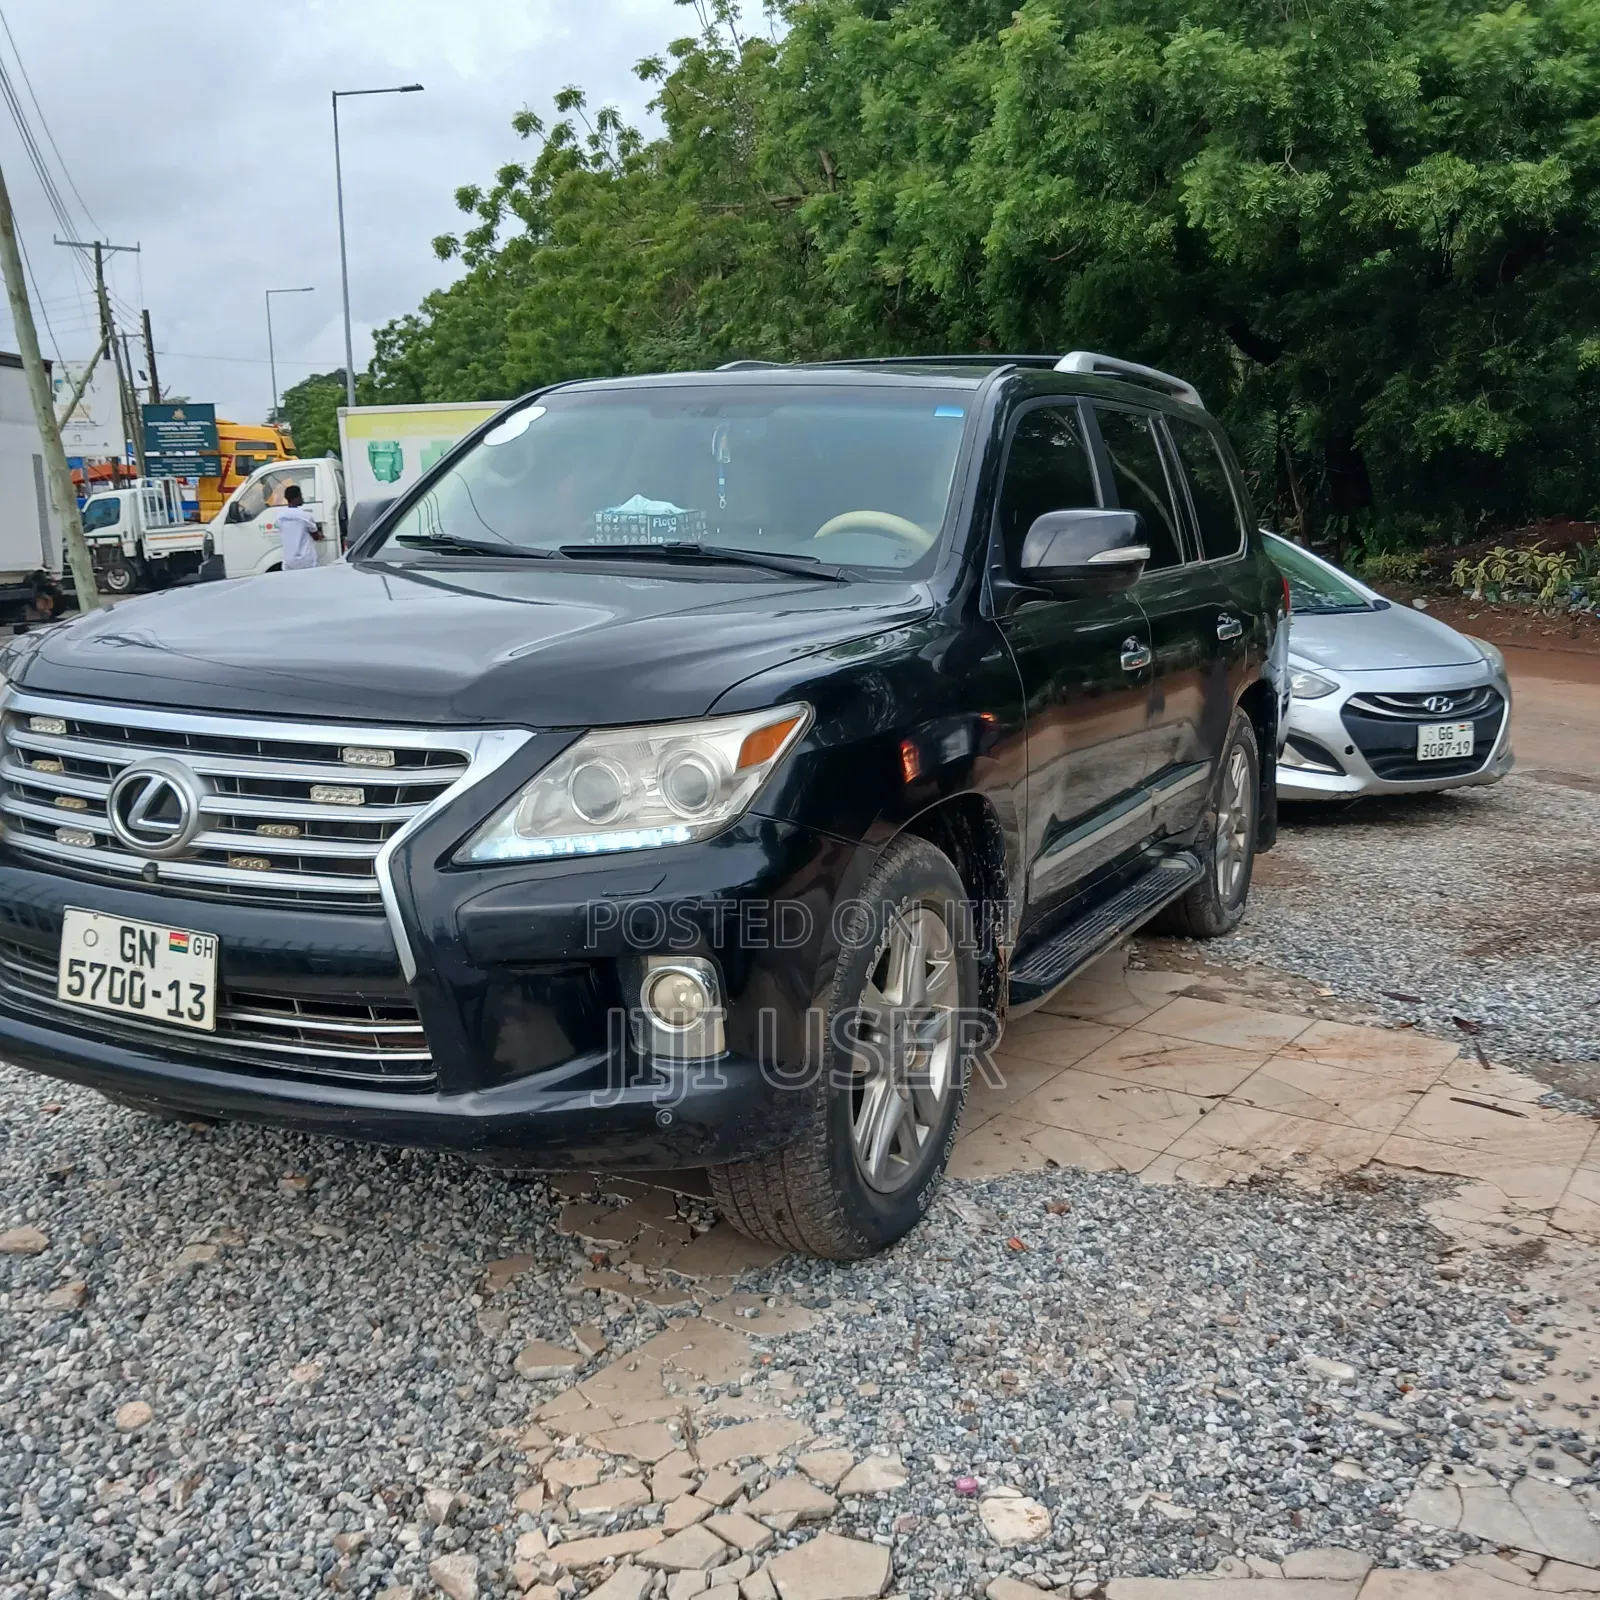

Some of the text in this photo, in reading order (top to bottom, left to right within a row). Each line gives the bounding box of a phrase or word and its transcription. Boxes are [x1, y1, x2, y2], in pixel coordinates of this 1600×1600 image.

[1438, 726, 1454, 740] GG
[1422, 741, 1470, 757] 3087-19
[120, 925, 157, 969] GN
[193, 937, 214, 959] GH
[66, 958, 206, 1022] 5700-13
